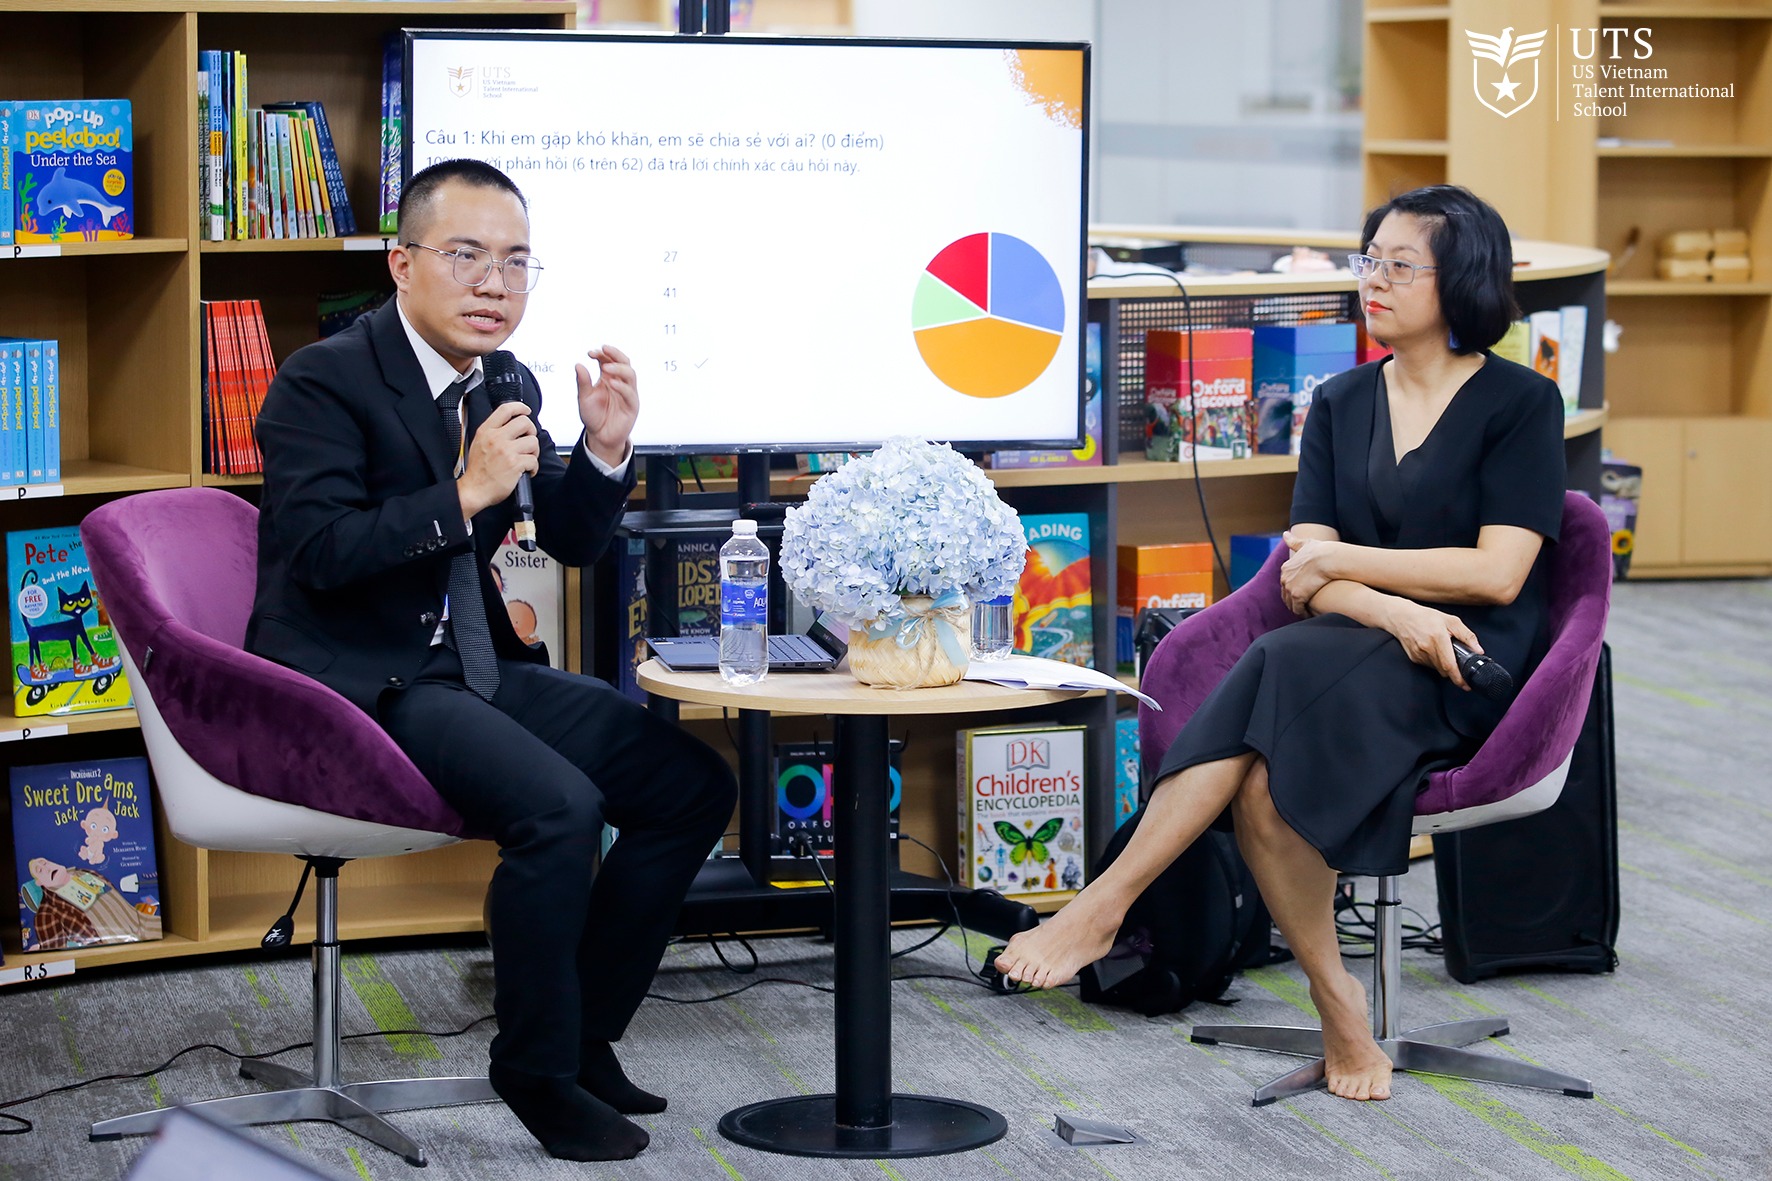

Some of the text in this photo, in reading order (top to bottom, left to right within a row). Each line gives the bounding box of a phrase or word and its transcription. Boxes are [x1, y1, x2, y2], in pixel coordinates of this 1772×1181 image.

[482, 66, 511, 78] UTS
[44, 107, 104, 128] pop-up
[26, 126, 120, 154] peekaboo!
[426, 129, 884, 150] Câu 1: Khi em gặp khó khăn, em sẽ chia sẻ với ai? (0 điểm)
[30, 153, 117, 167] Under the Sea
[506, 157, 541, 173] phản
[546, 156, 570, 170] hồi
[572, 157, 586, 172] (6
[590, 157, 617, 170] trên
[622, 158, 644, 172] 62)
[648, 158, 664, 170] đã
[670, 158, 688, 171] trả
[692, 158, 708, 171] lời
[713, 158, 750, 172] chính
[754, 159, 776, 172] xác
[780, 159, 804, 172] câu
[808, 158, 829, 172] hỏi
[834, 160, 860, 175] này.
[14, 246, 22, 258] P
[382, 238, 389, 250] T
[663, 250, 678, 262] 27
[663, 287, 676, 298] 41
[664, 324, 676, 335] 11
[528, 360, 555, 373] khác
[664, 360, 678, 372] 15
[1192, 378, 1246, 398] Oxford
[18, 488, 26, 499] P
[1029, 523, 1082, 541] ADING
[26, 540, 82, 566] Pete the
[678, 543, 716, 553] ANNICA
[505, 550, 548, 568] Sister
[42, 565, 90, 584] and the New
[678, 560, 716, 586] IDS'
[24, 594, 42, 604] FREE
[1148, 592, 1205, 608] Oxford
[22, 728, 31, 740] P
[1011, 740, 1045, 765] DK
[24, 773, 137, 808] Sweet Dreams,
[976, 770, 1080, 797] Children's
[976, 794, 1080, 812] ENCYCLOPEDIA
[54, 800, 140, 826] Jack- Jack
[788, 820, 831, 829] OXFO
[24, 963, 48, 980] R.S
